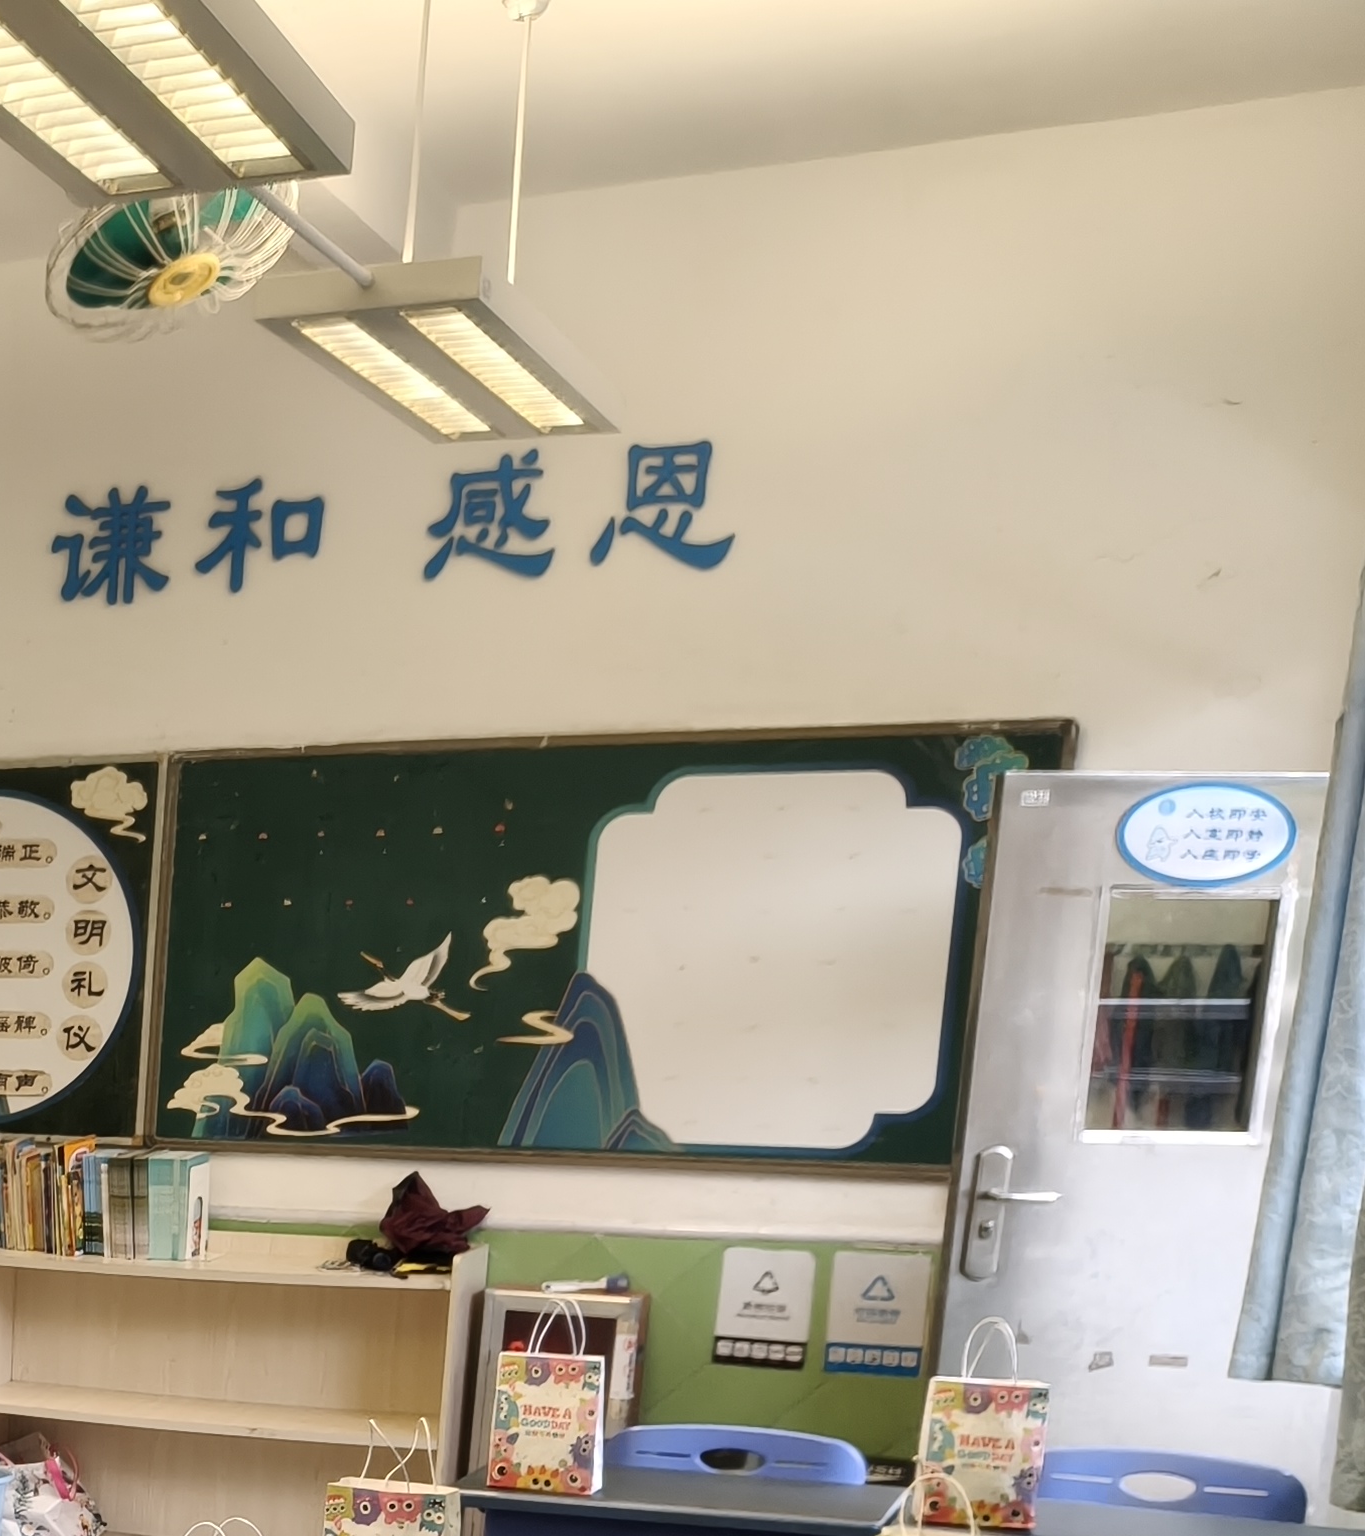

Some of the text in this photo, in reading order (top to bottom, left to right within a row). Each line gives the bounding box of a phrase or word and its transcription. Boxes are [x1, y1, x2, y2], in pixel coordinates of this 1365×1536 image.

[53, 477, 326, 606] 谦和
[422, 440, 736, 580] 感恩
[63, 863, 107, 1052] 文明礼仪
[523, 1405, 572, 1419] HAVE A
[959, 1435, 1001, 1449] HAVE
